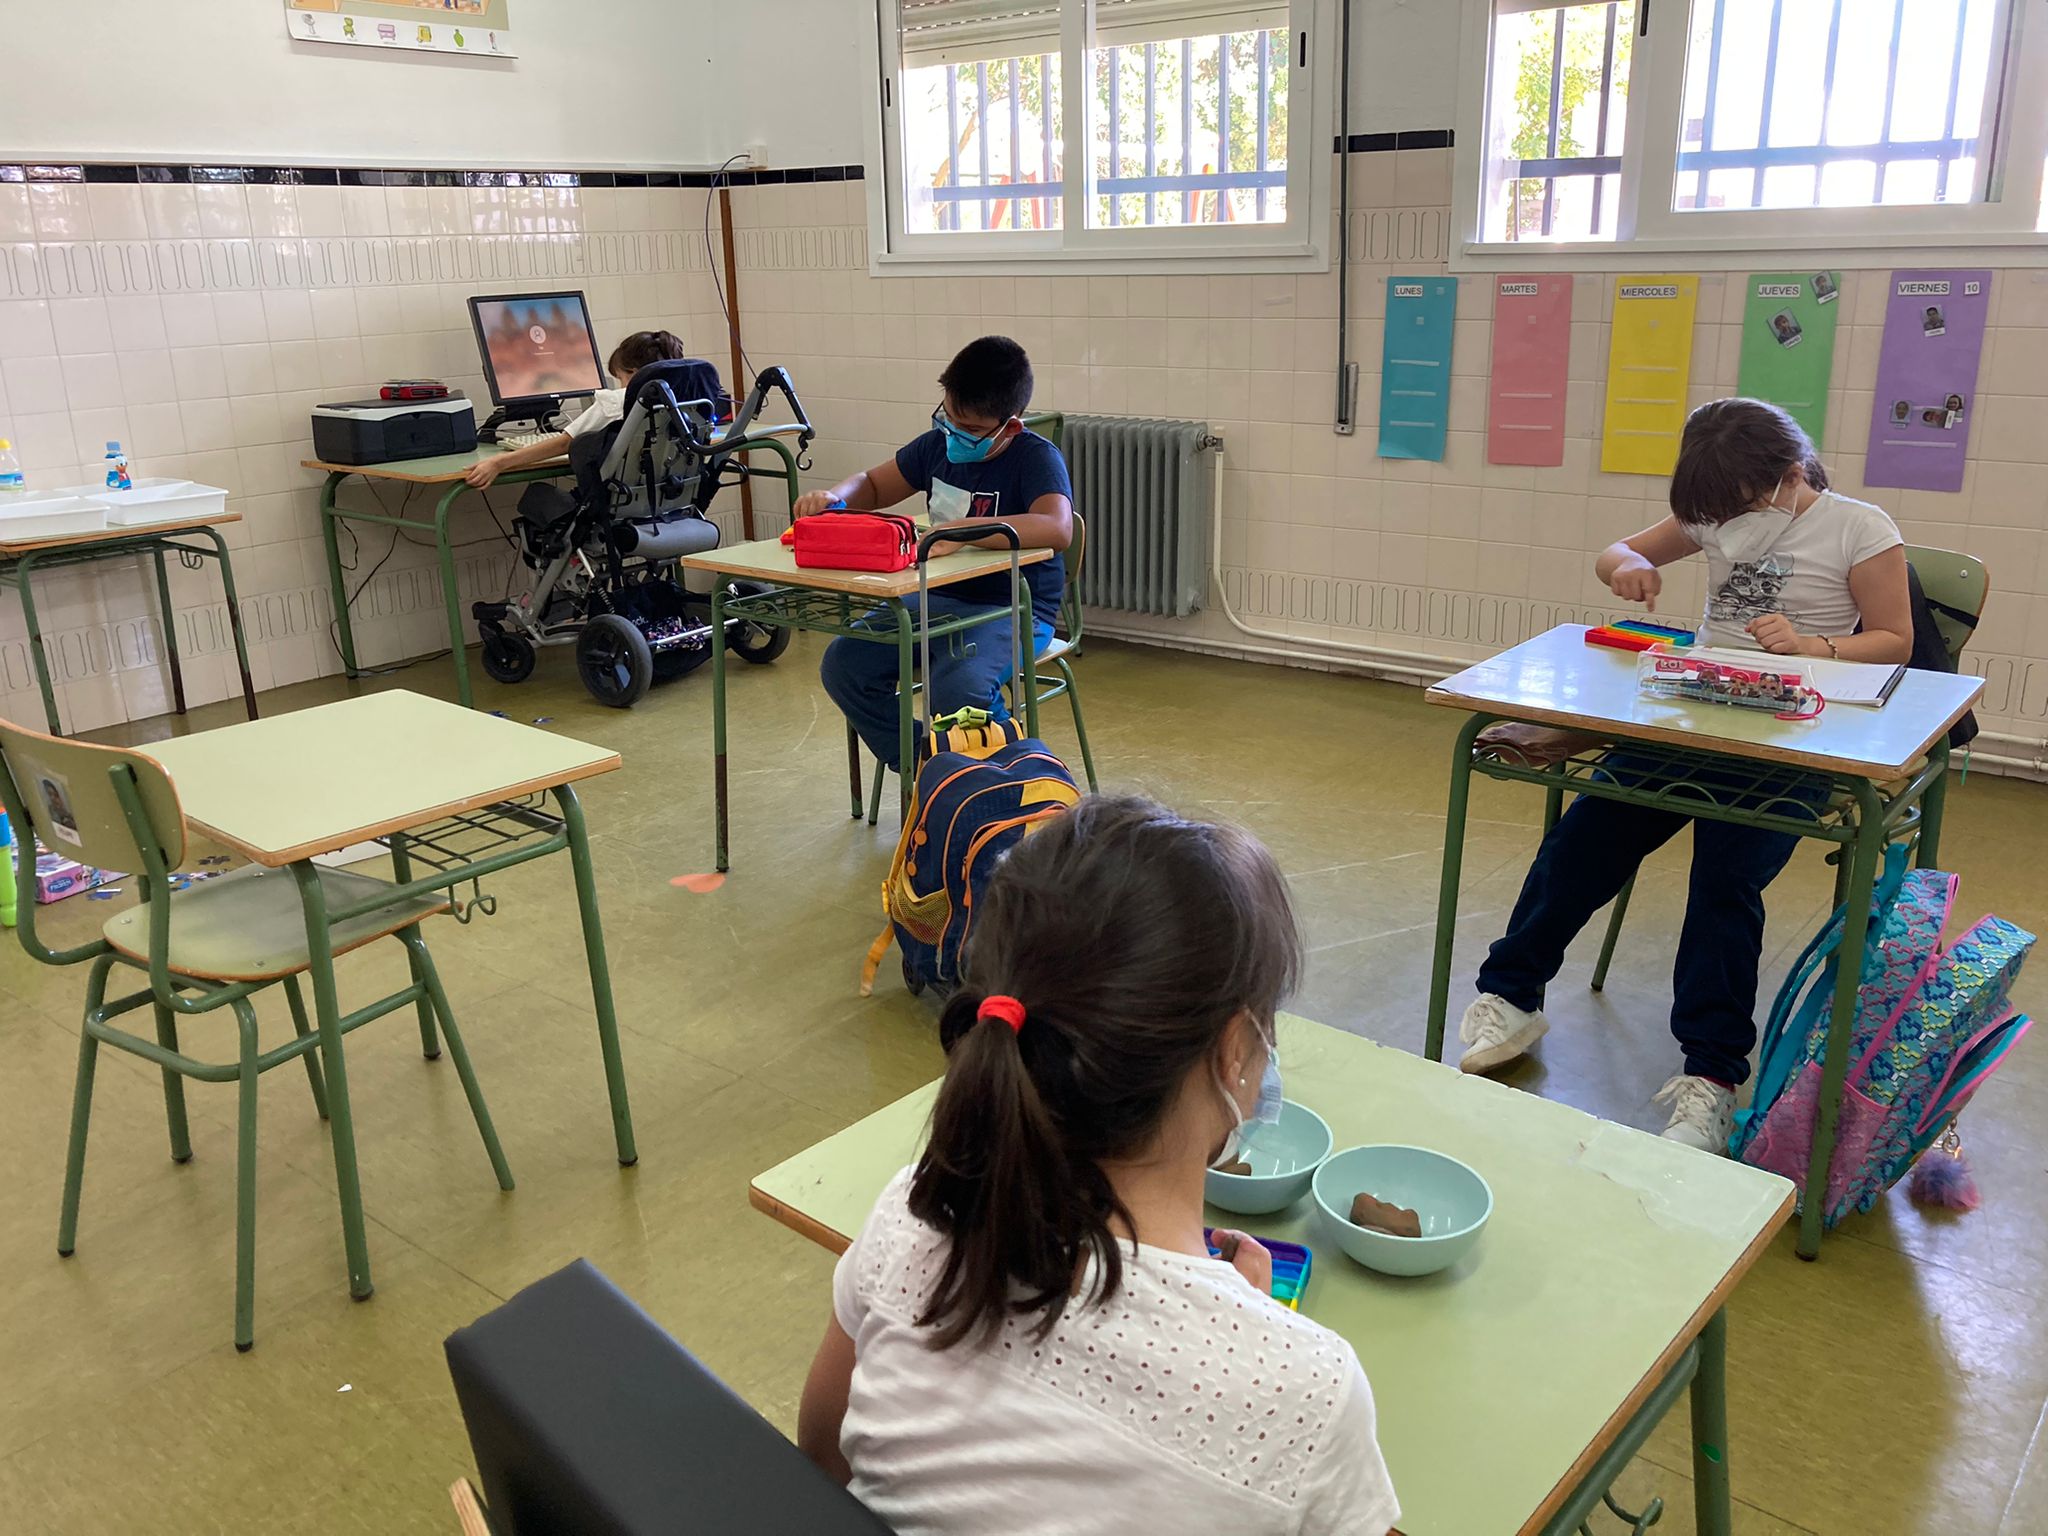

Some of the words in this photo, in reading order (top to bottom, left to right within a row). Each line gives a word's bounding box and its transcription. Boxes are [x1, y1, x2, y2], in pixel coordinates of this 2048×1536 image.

[1395, 287, 1422, 295] LUNES
[1502, 285, 1537, 293] MARTES
[1621, 287, 1676, 296] MIERCOLES
[1758, 286, 1800, 296] JUEVES
[1899, 283, 1949, 293] VIERNES
[1966, 284, 1978, 292] 10
